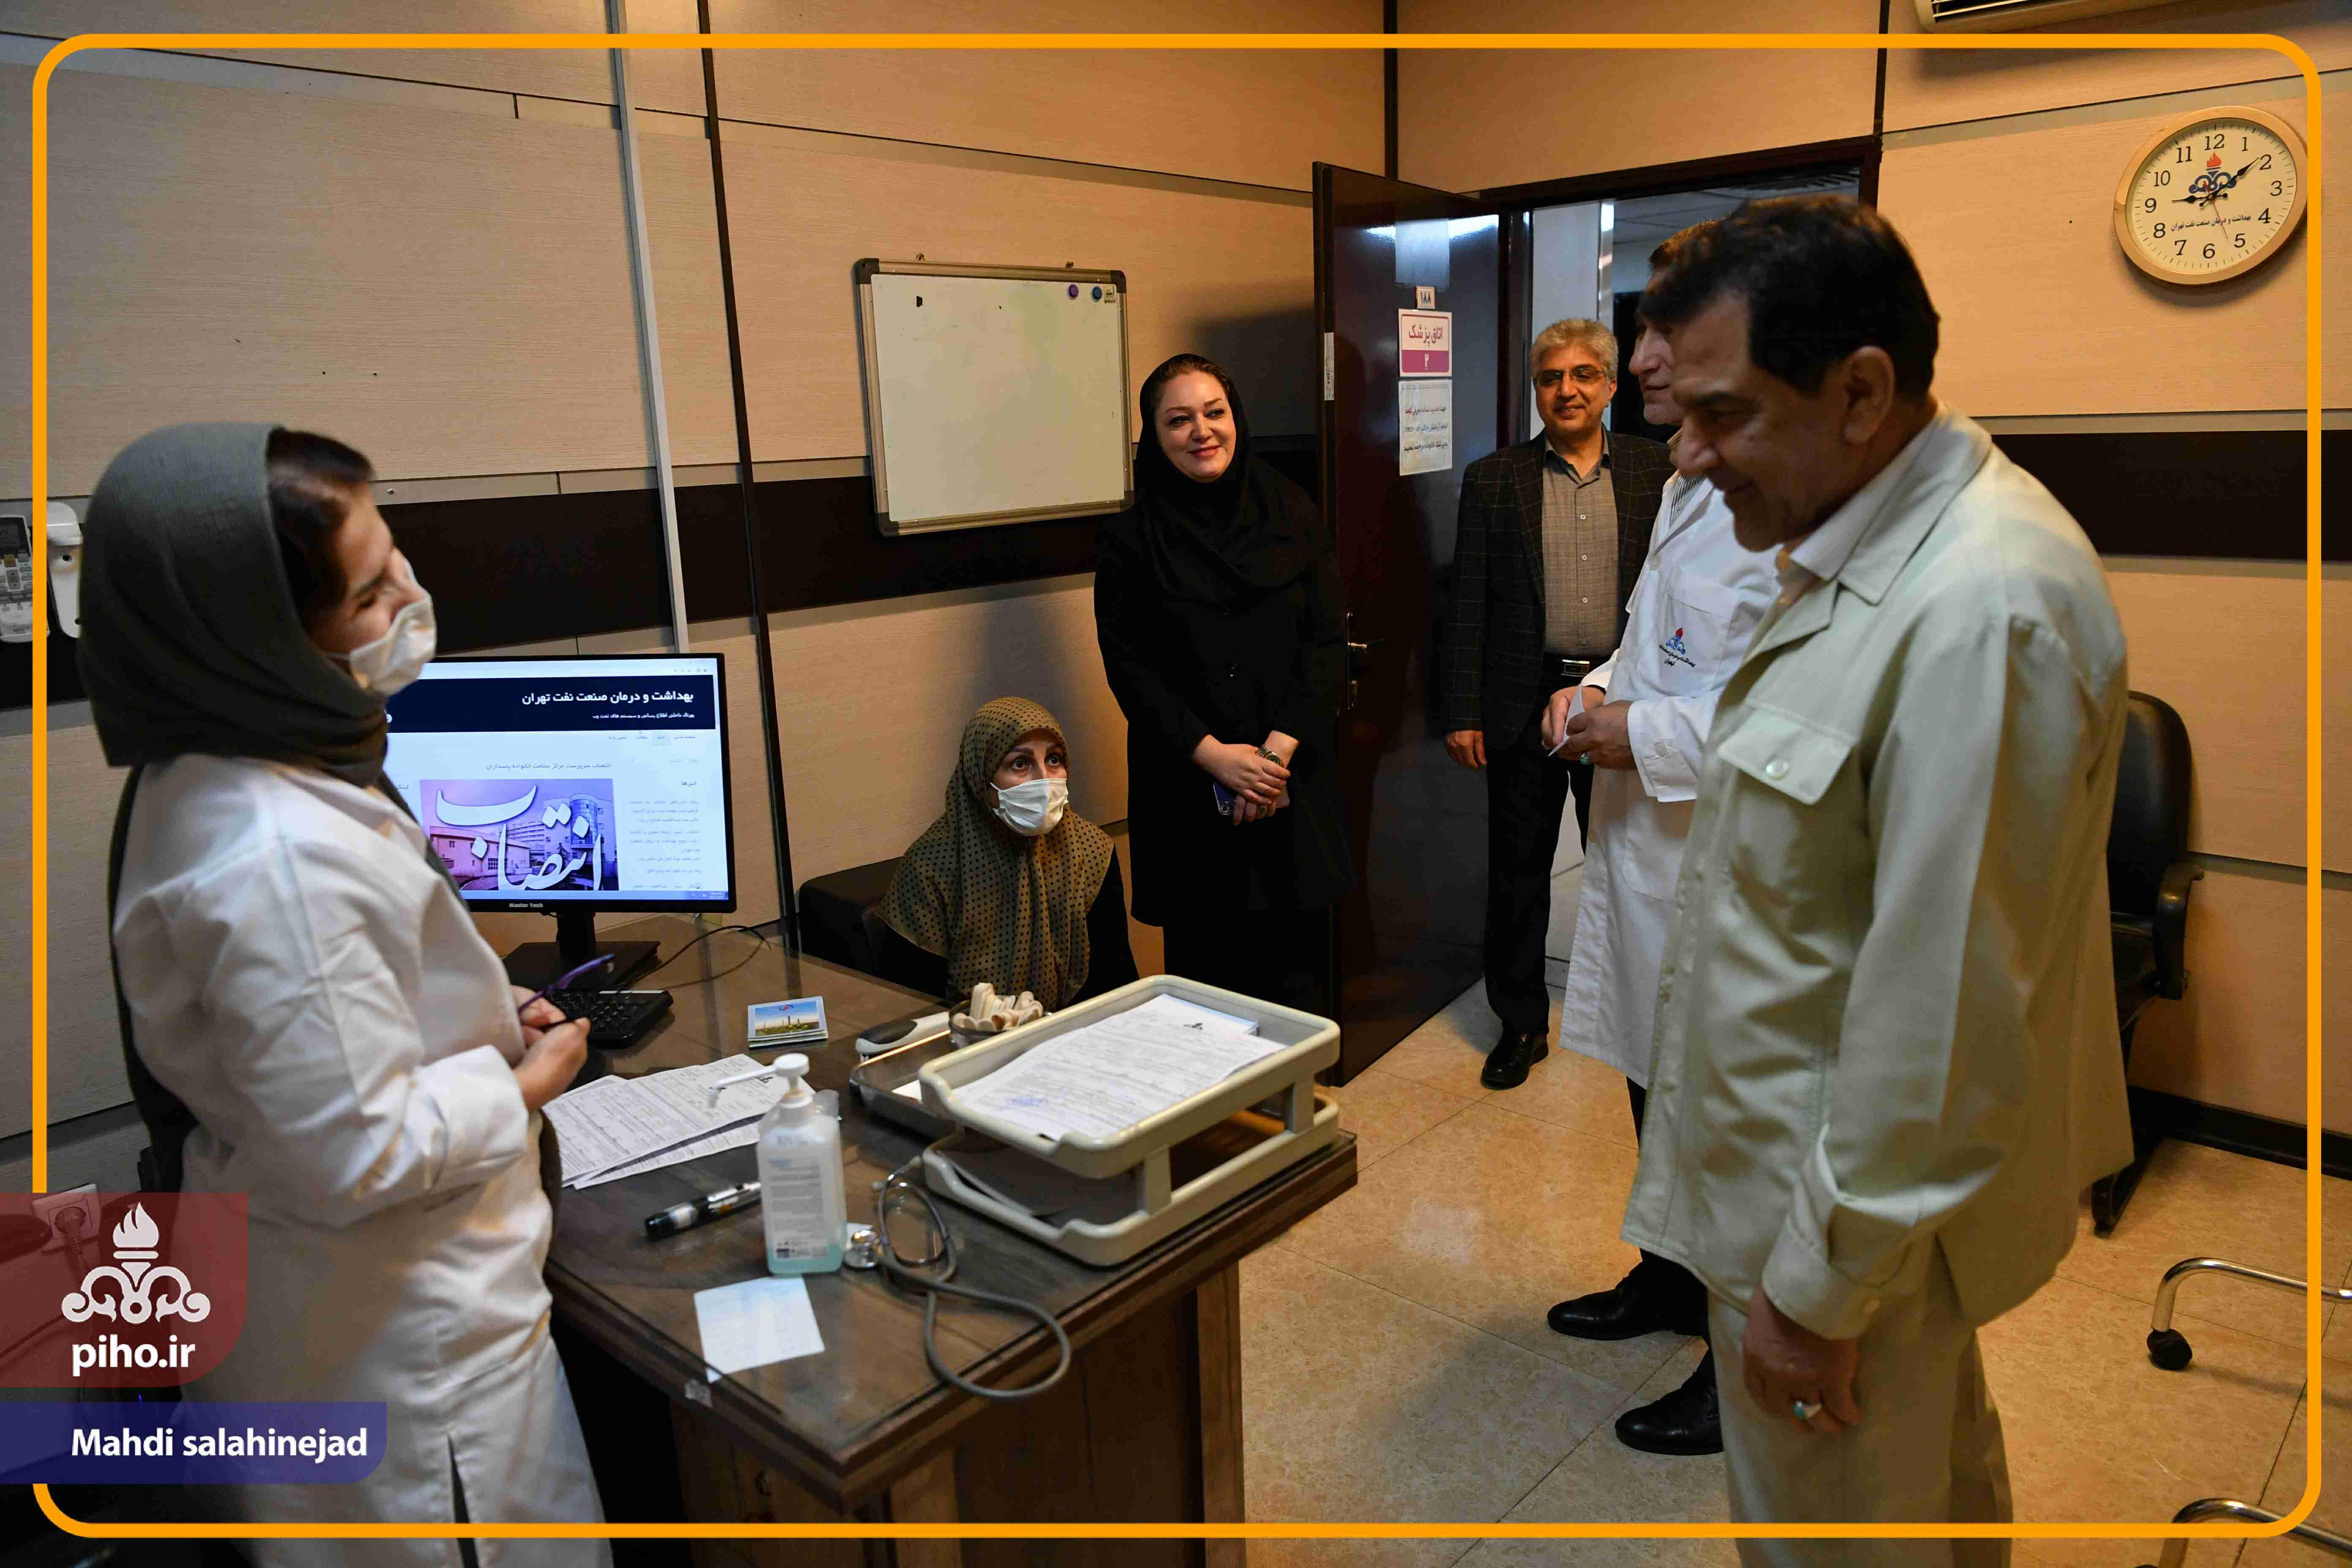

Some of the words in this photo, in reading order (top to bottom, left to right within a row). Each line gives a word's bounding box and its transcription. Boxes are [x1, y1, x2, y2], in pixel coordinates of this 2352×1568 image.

[2204, 133, 2225, 150] 12
[2241, 136, 2248, 152] 1
[2176, 146, 2193, 163] 11
[2259, 154, 2272, 170] 2
[2154, 170, 2170, 187] 10
[2270, 180, 2282, 196] 3
[2145, 197, 2156, 213] 9
[2257, 207, 2271, 224] 4
[2153, 223, 2166, 239] 8
[2174, 240, 2187, 256] 7
[2234, 233, 2246, 248] 5
[2203, 243, 2215, 259] 6
[522, 693, 551, 705] تهران
[553, 692, 574, 701] نفت
[576, 692, 607, 701] صنعت
[610, 691, 640, 704] درمان
[642, 695, 649, 703] و
[651, 691, 694, 703] بهداشت
